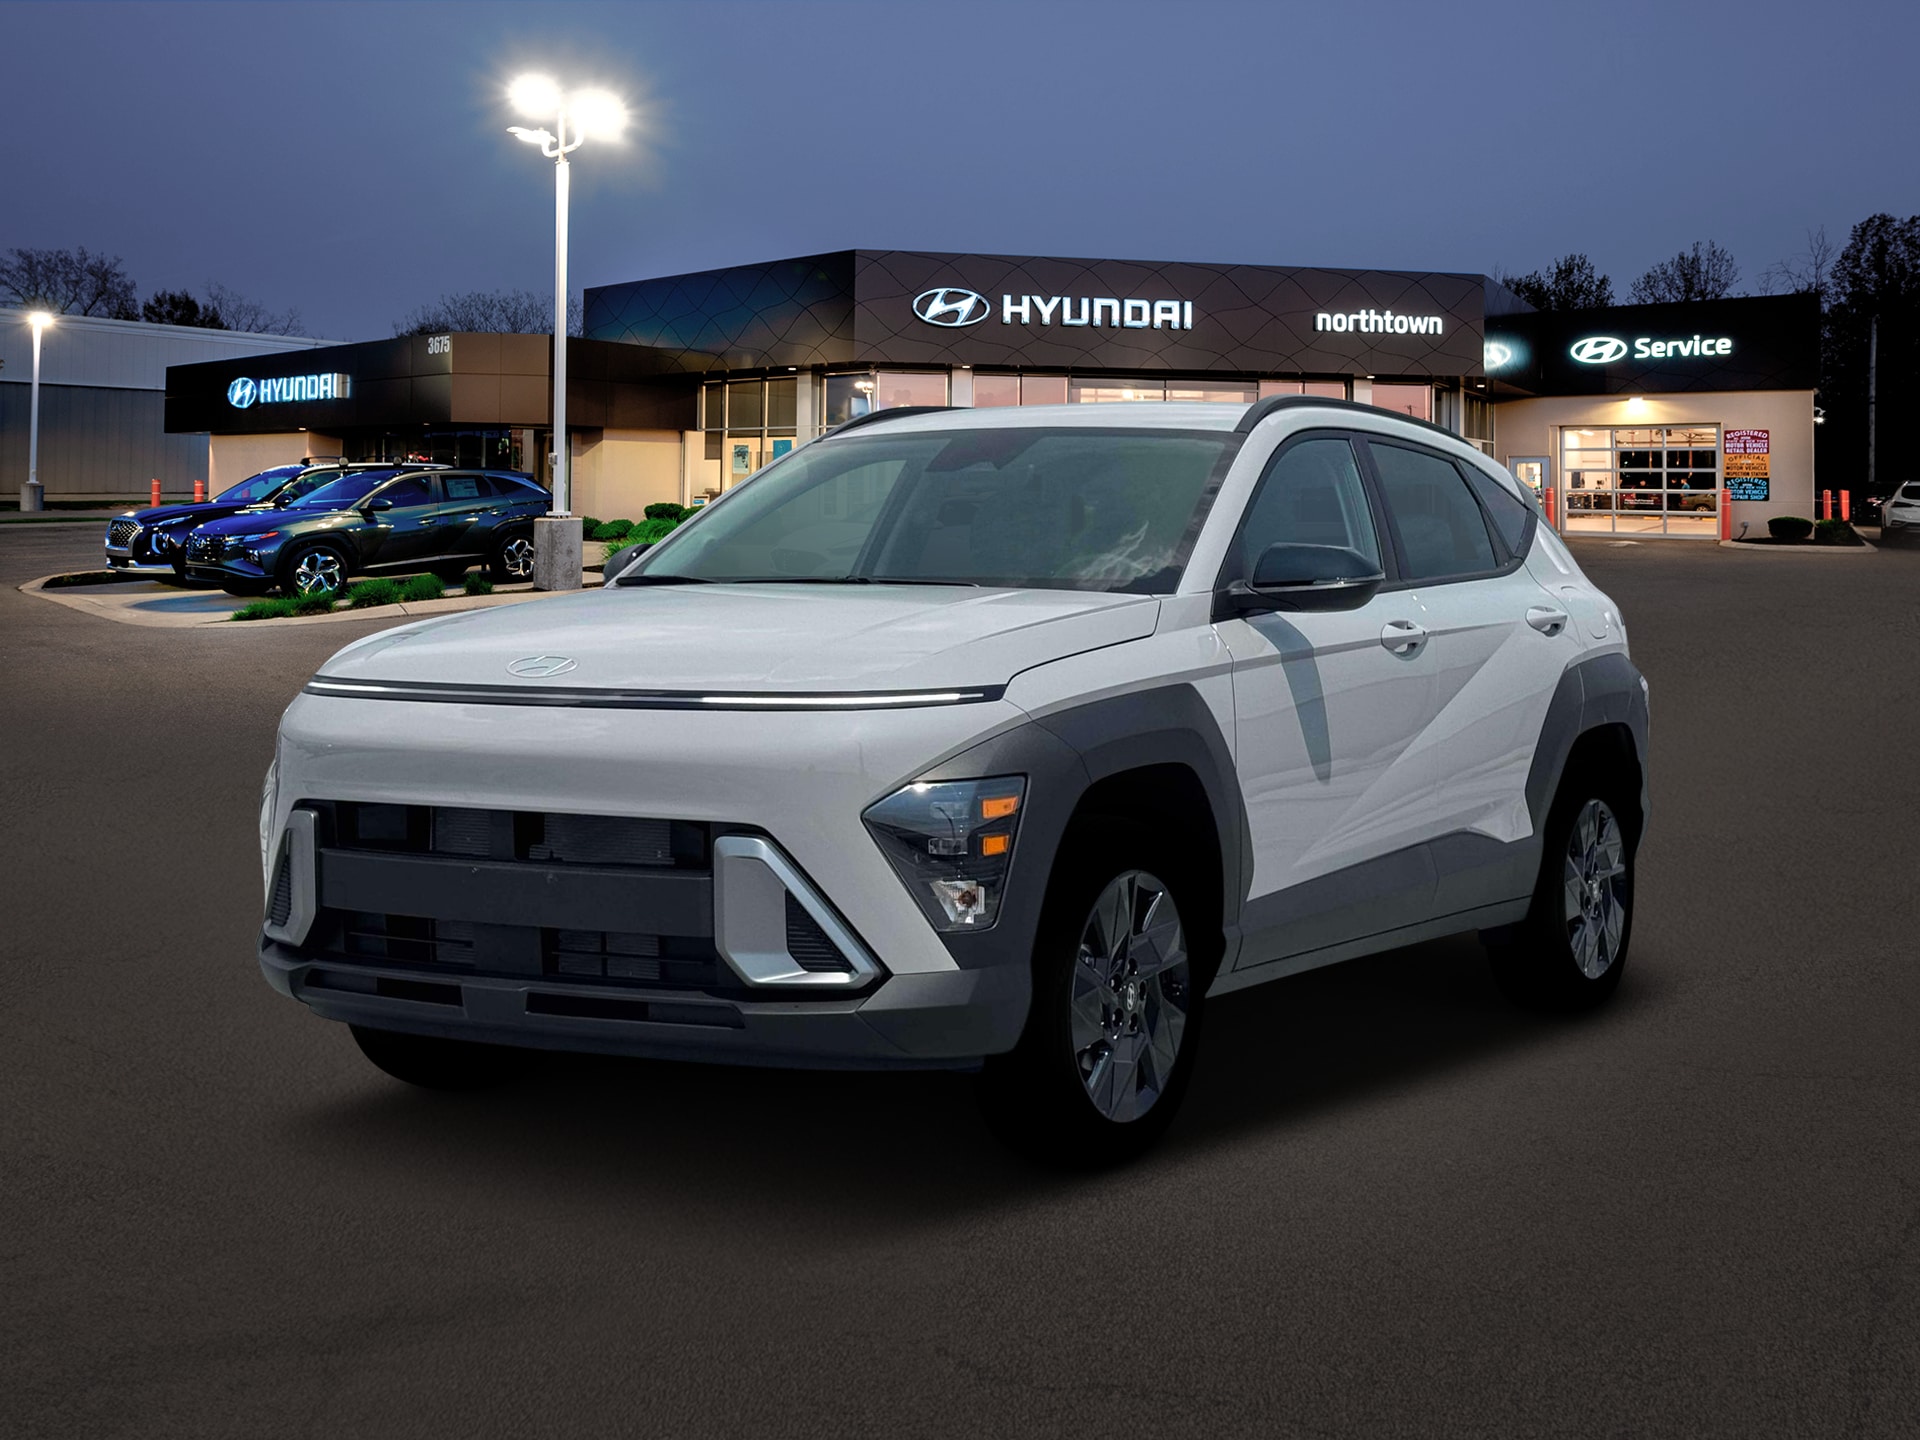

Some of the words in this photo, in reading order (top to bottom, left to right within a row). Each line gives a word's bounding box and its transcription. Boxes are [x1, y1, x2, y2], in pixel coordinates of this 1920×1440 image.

[1002, 294, 1193, 330] HYUNDAI
[1317, 309, 1443, 335] northtown
[428, 335, 450, 355] 3675
[1634, 334, 1732, 359] Service
[260, 372, 340, 404] HYUNDAI
[1726, 430, 1768, 439] REGISTERED
[1728, 454, 1766, 462] OFFICIAL
[1726, 478, 1767, 486] REGISTERED
